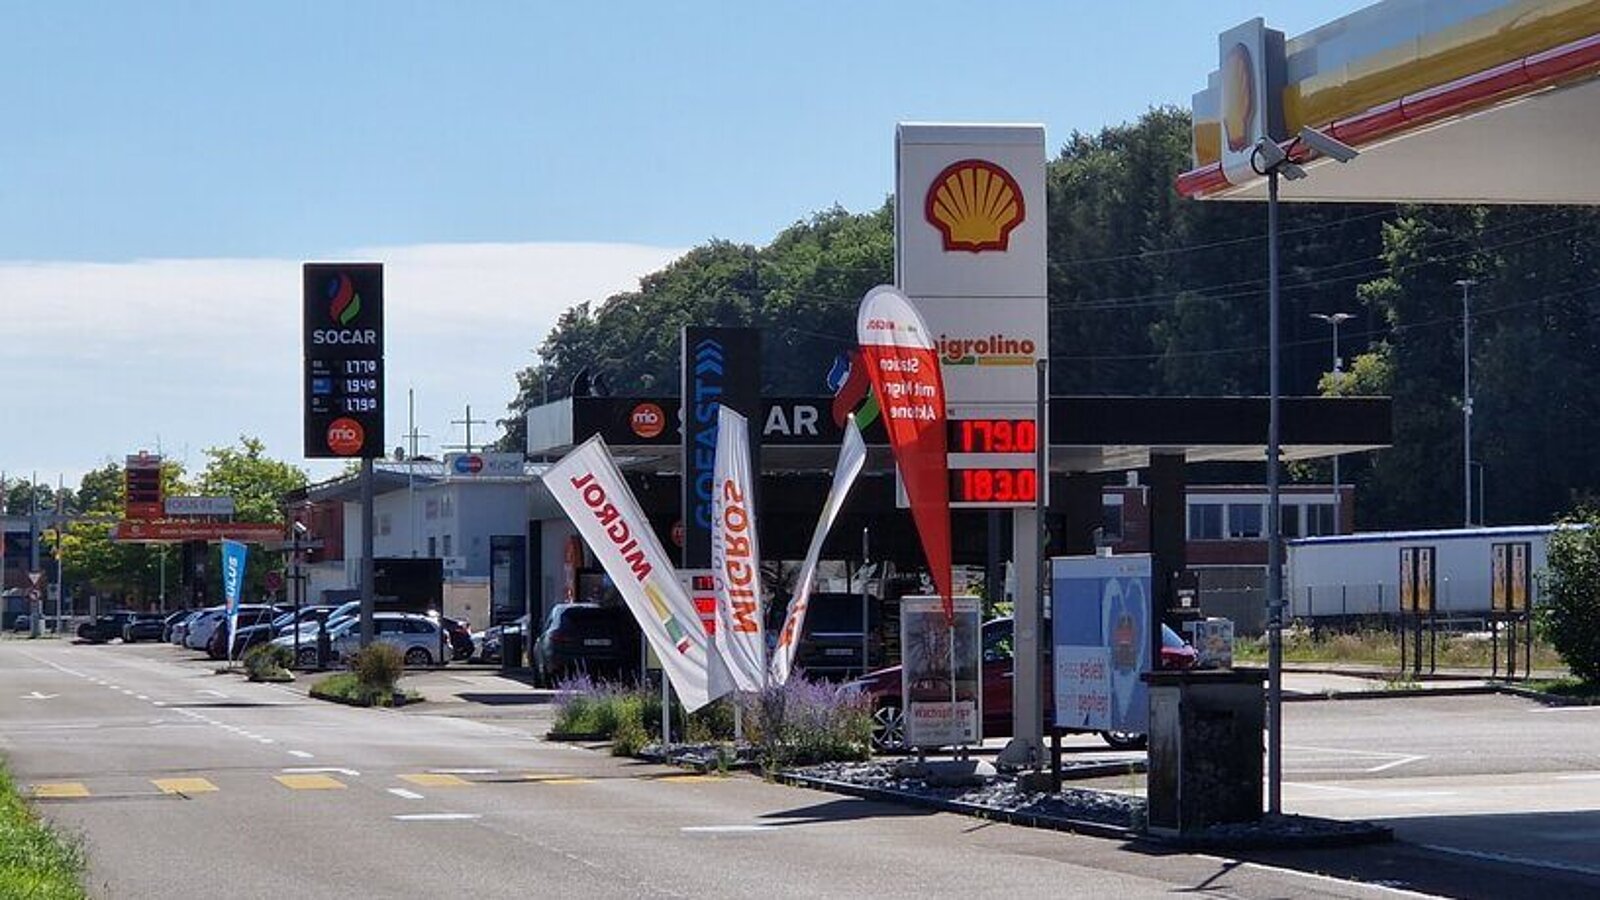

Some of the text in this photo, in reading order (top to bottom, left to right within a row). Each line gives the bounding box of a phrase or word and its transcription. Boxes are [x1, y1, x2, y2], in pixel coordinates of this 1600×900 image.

[313, 330, 376, 344] SOCAR
[633, 408, 658, 424] mio
[962, 420, 1036, 452] 179.0
[963, 469, 1036, 501] 183.0
